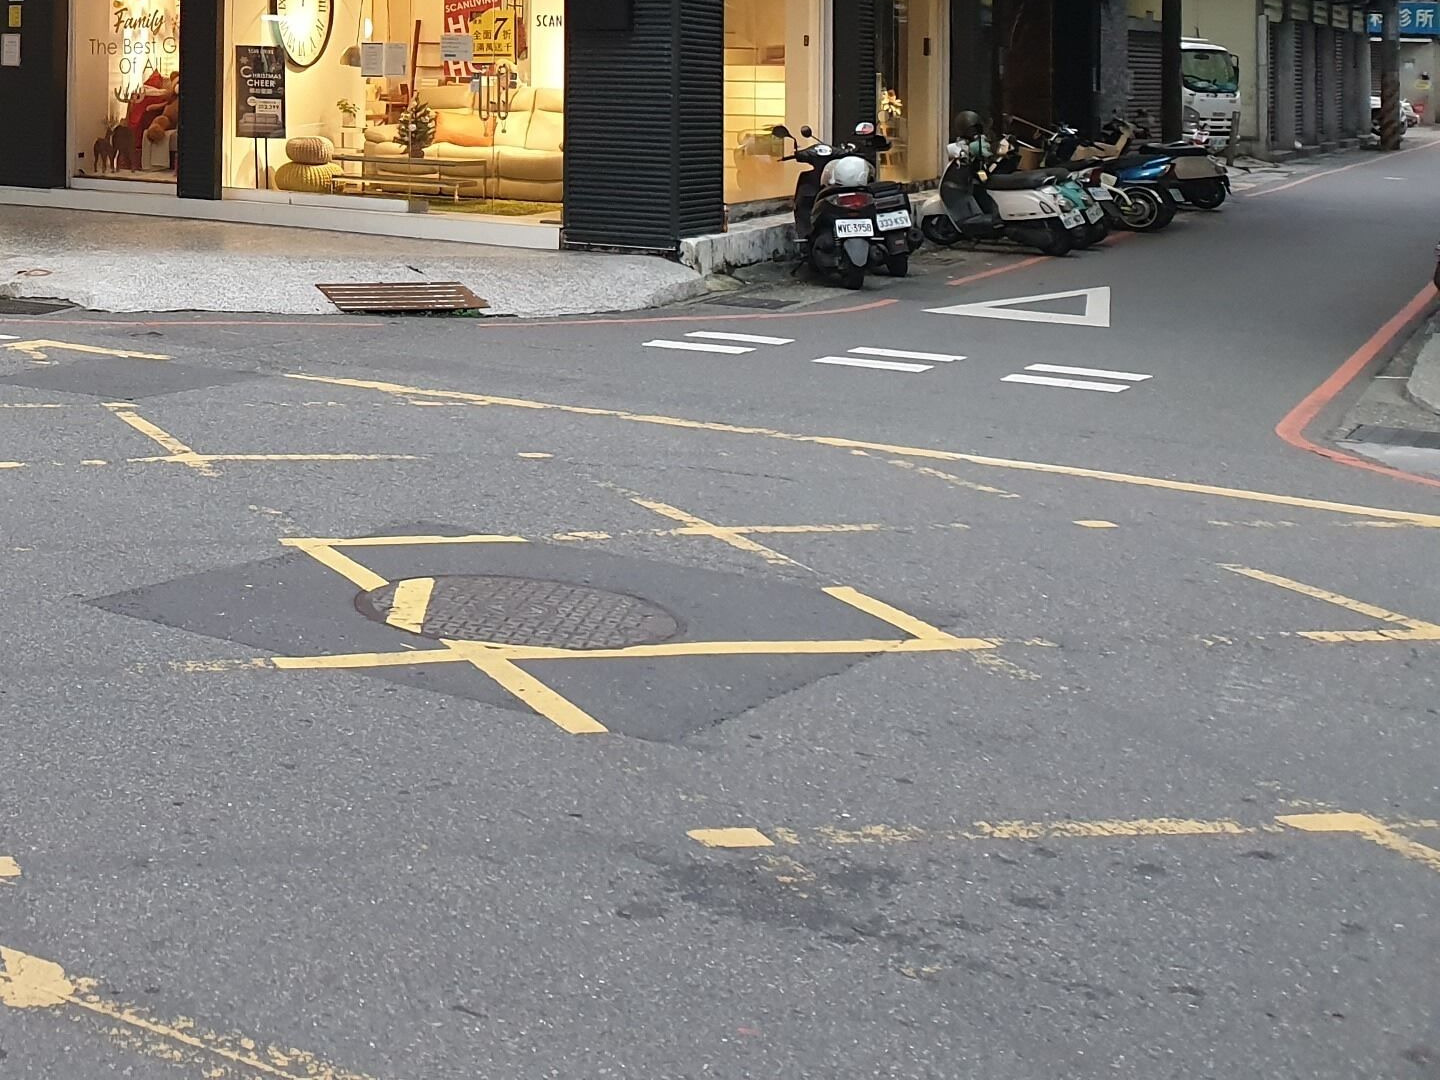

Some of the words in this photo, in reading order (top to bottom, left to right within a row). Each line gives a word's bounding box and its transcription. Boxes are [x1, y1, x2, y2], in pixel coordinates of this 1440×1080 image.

[114, 7, 163, 35] Family
[89, 39, 117, 55] The
[124, 37, 157, 55] Best
[119, 57, 136, 74] Of
[247, 79, 276, 87] CHEER
